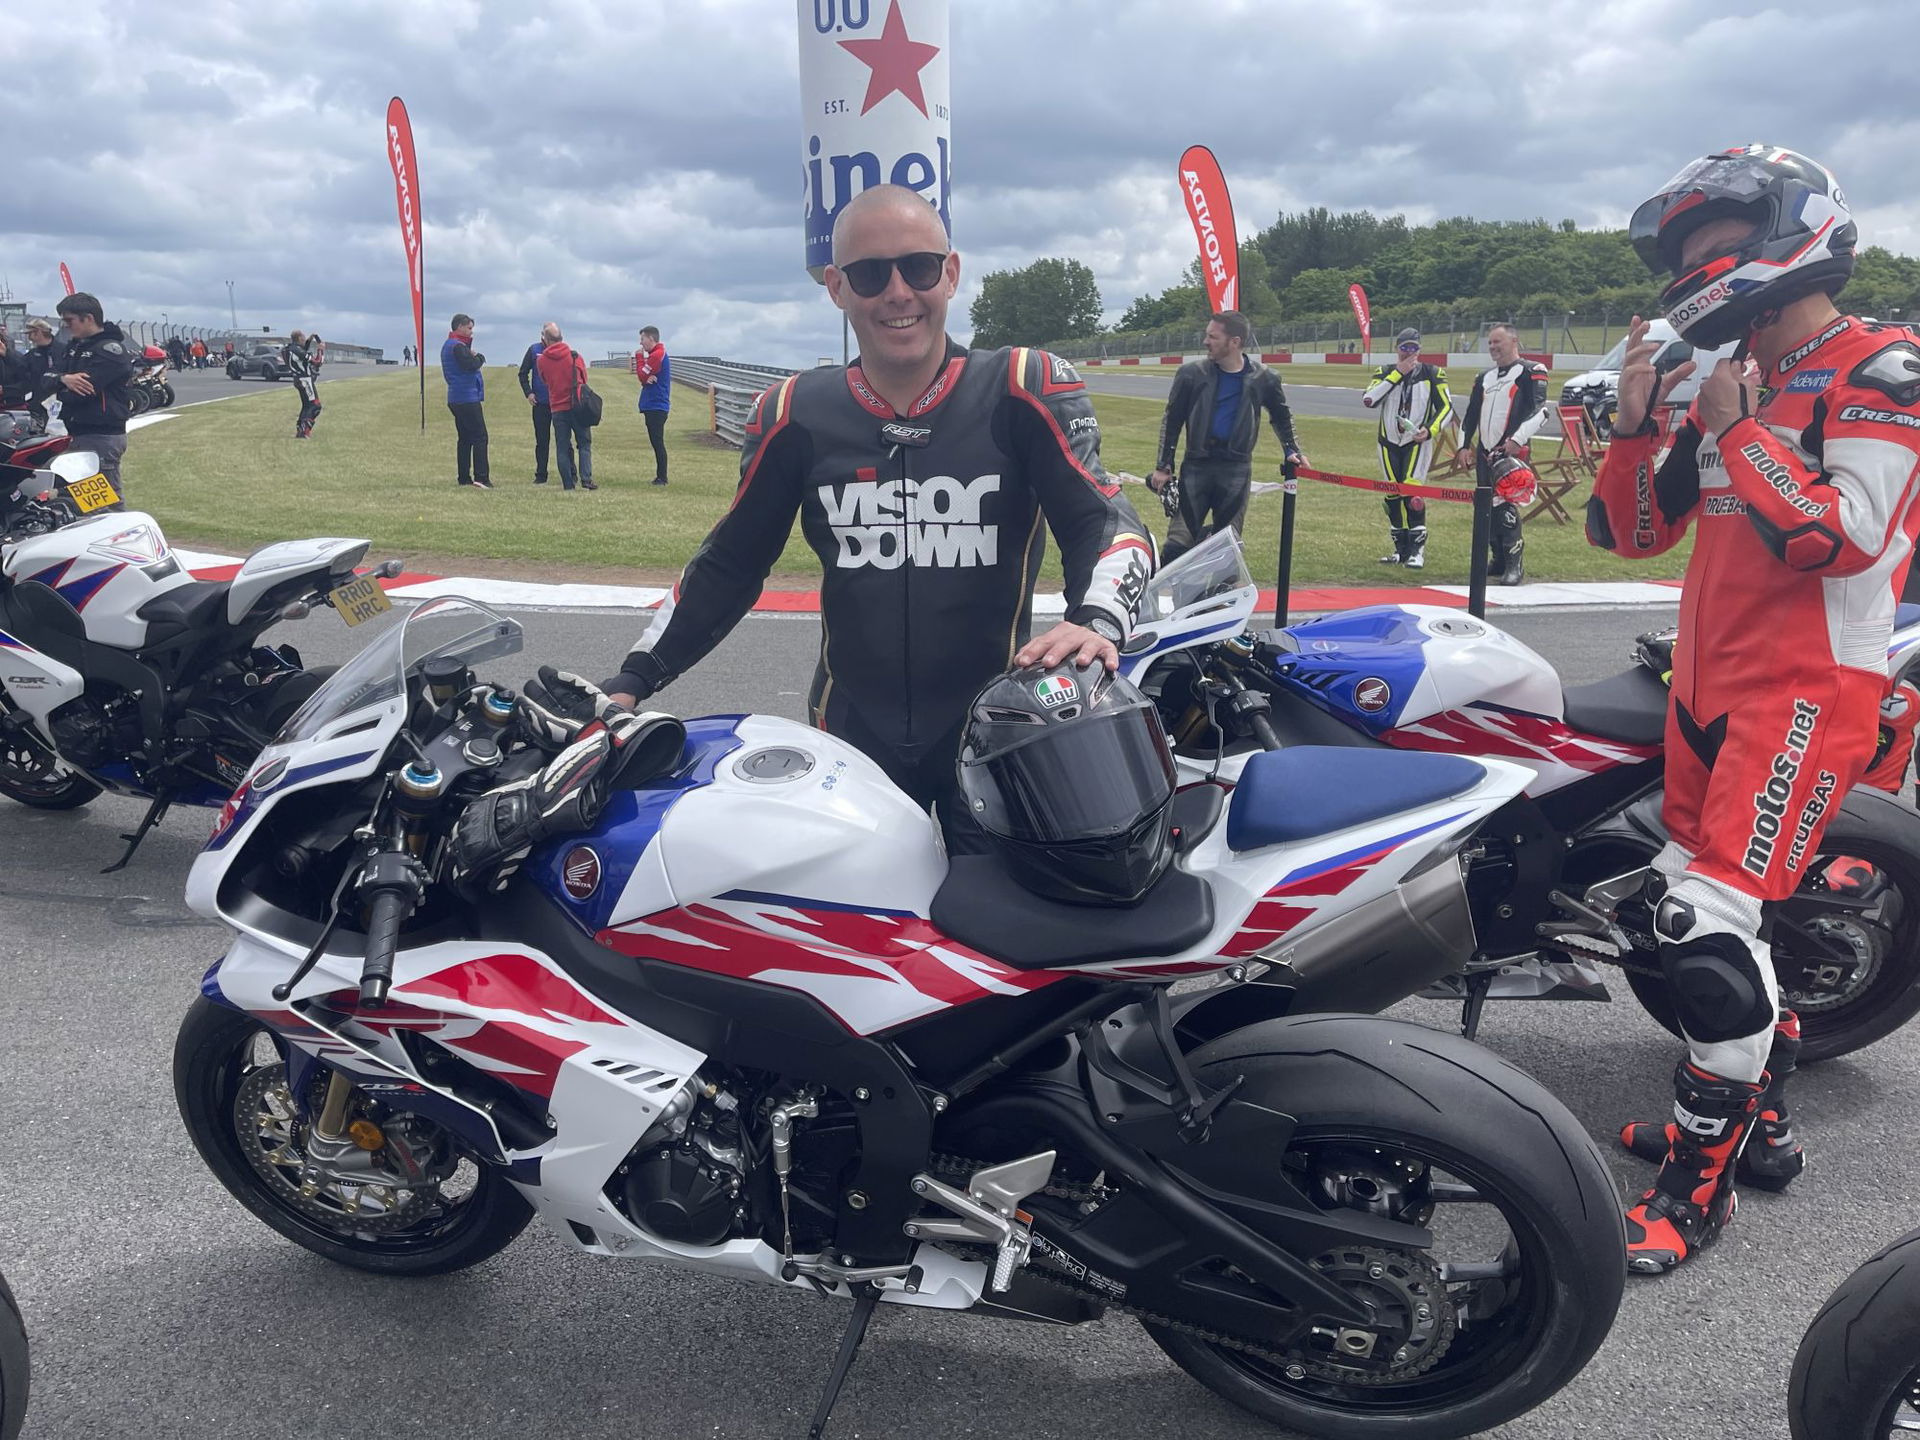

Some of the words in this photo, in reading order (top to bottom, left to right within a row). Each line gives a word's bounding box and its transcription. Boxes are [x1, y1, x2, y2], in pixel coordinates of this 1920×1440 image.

[824, 100, 849, 114] EST.
[1780, 320, 1849, 374] CREAM
[1788, 373, 1833, 389] Adevinta
[852, 382, 885, 408] RST
[916, 375, 948, 413] RST
[882, 423, 931, 438] RST
[70, 477, 109, 497] BG08
[1373, 482, 1400, 493] HONDA
[1740, 441, 1831, 518] motos.net
[82, 490, 109, 507] VPF
[1441, 489, 1475, 501] HONDA
[831, 523, 999, 570] DOWN
[350, 597, 384, 622] HRC
[1045, 685, 1076, 704] agv
[1742, 699, 1821, 879] motos.net
[1786, 770, 1837, 872] PRUEBAS
[565, 880, 592, 889] HONDA
